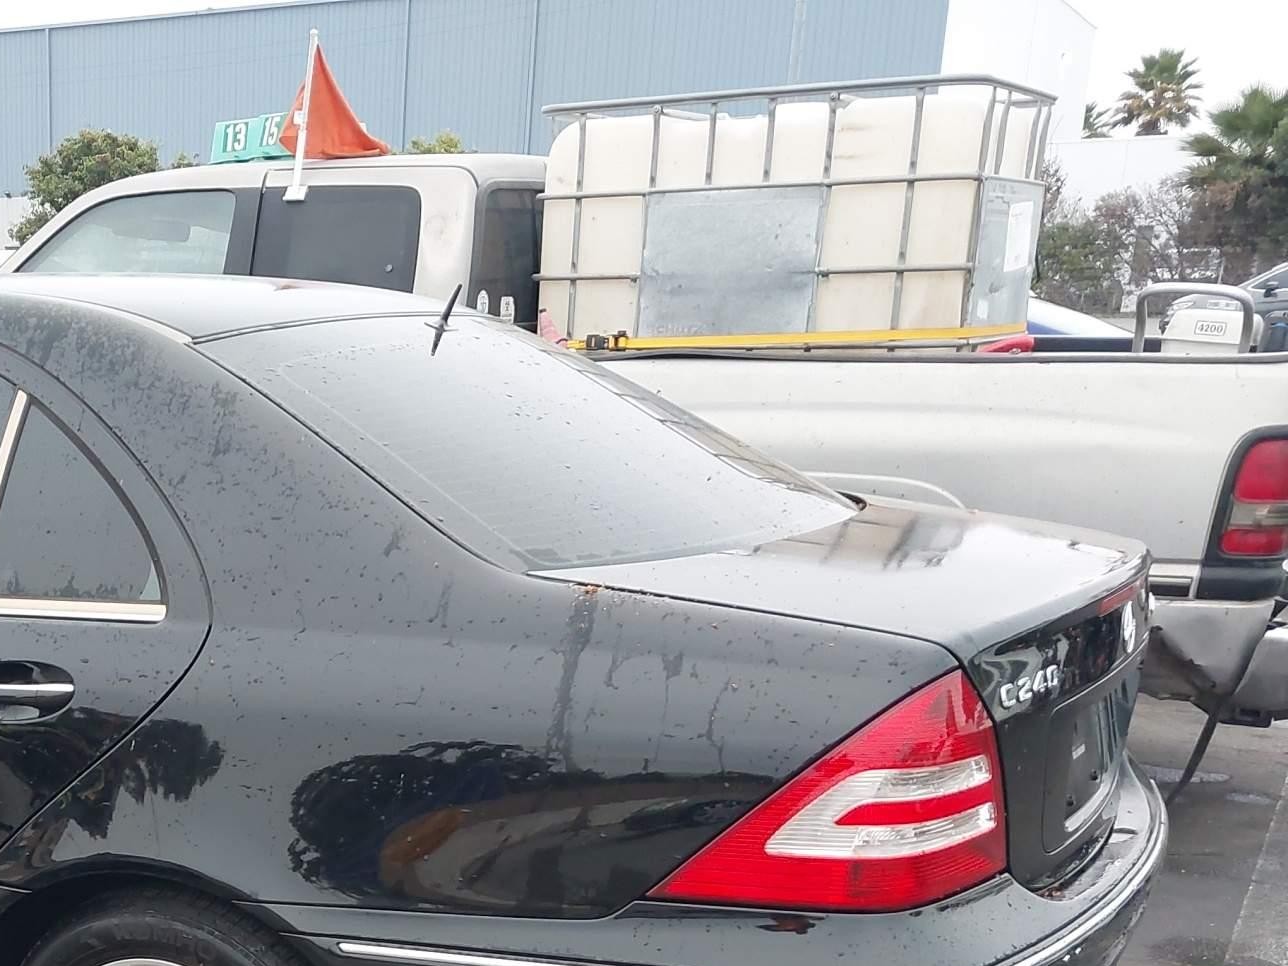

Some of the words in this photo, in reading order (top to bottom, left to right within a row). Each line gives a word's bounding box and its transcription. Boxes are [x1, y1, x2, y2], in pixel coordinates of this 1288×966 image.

[225, 122, 248, 152] 13
[263, 115, 281, 146] 15
[1197, 322, 1225, 335] 4200
[999, 664, 1060, 709] C240
